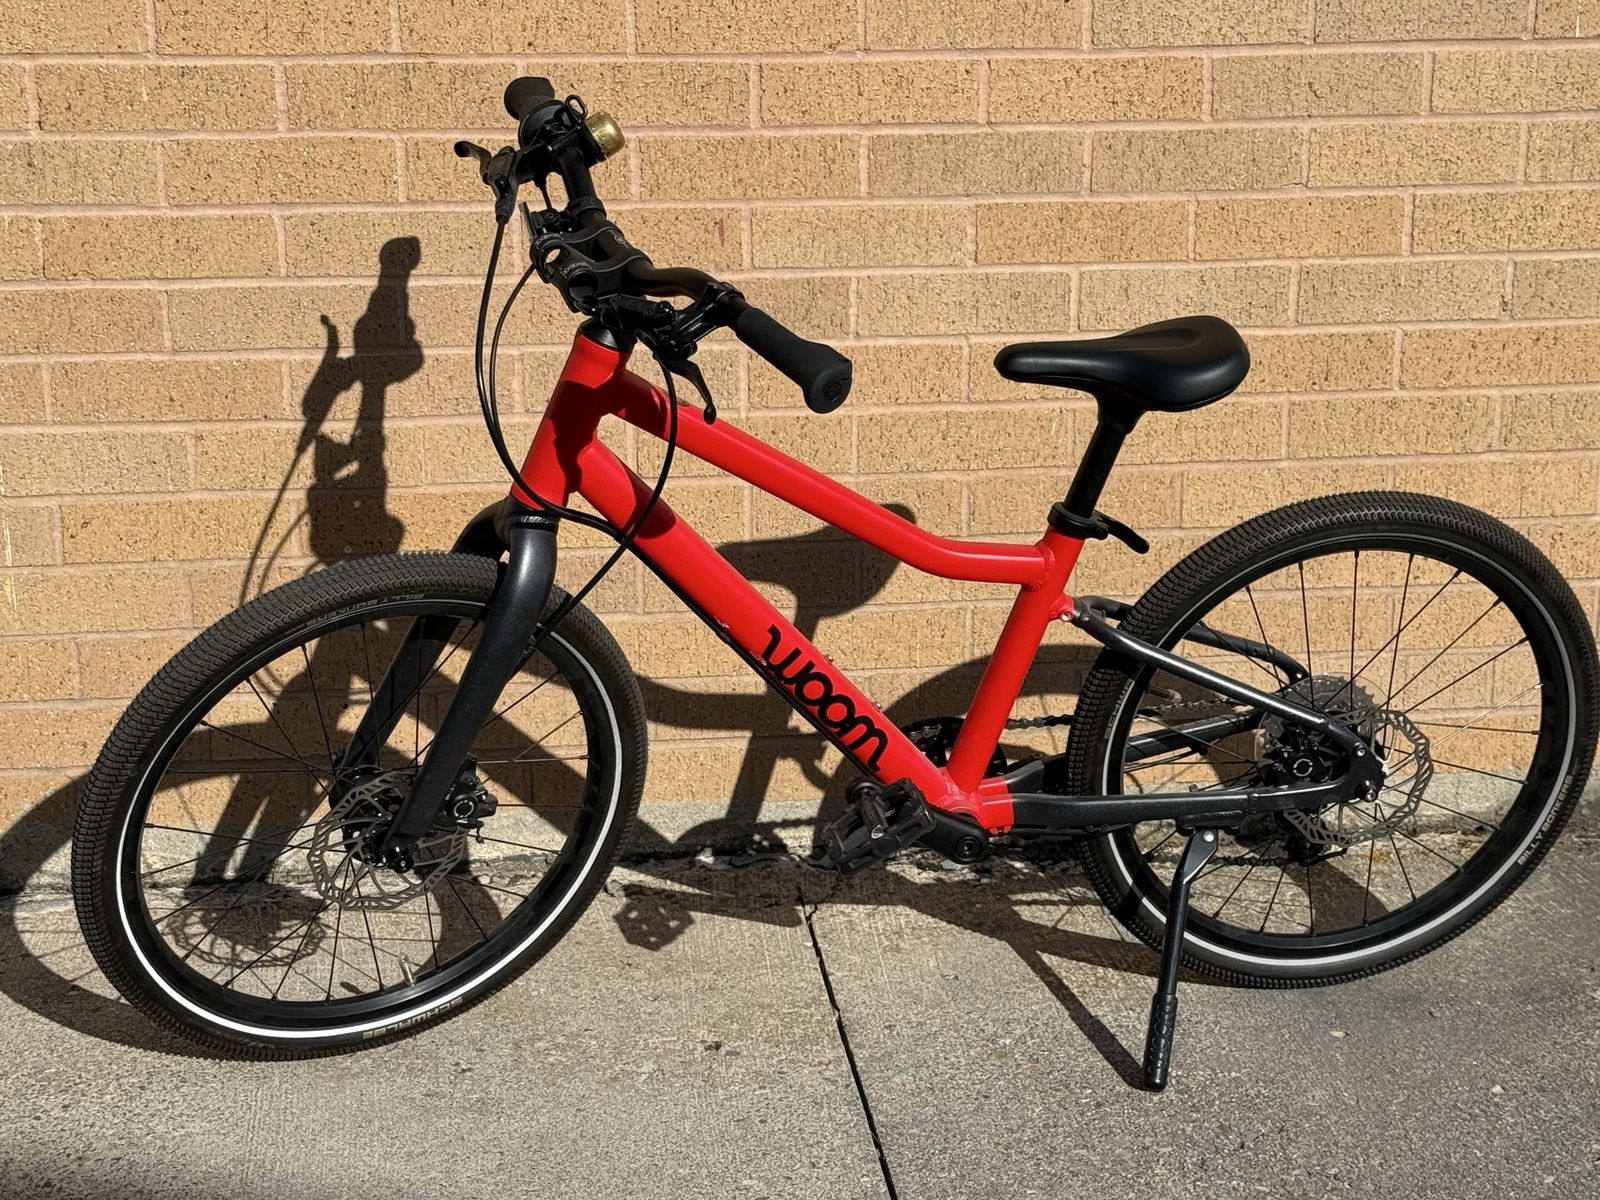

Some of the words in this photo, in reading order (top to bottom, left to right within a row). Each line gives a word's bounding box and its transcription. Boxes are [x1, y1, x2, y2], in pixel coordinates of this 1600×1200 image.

[761, 624, 888, 772] woom
[1517, 832, 1544, 866] BILLY
[1541, 773, 1575, 833] BONKERS
[363, 996, 463, 1040] SCHWALBE
